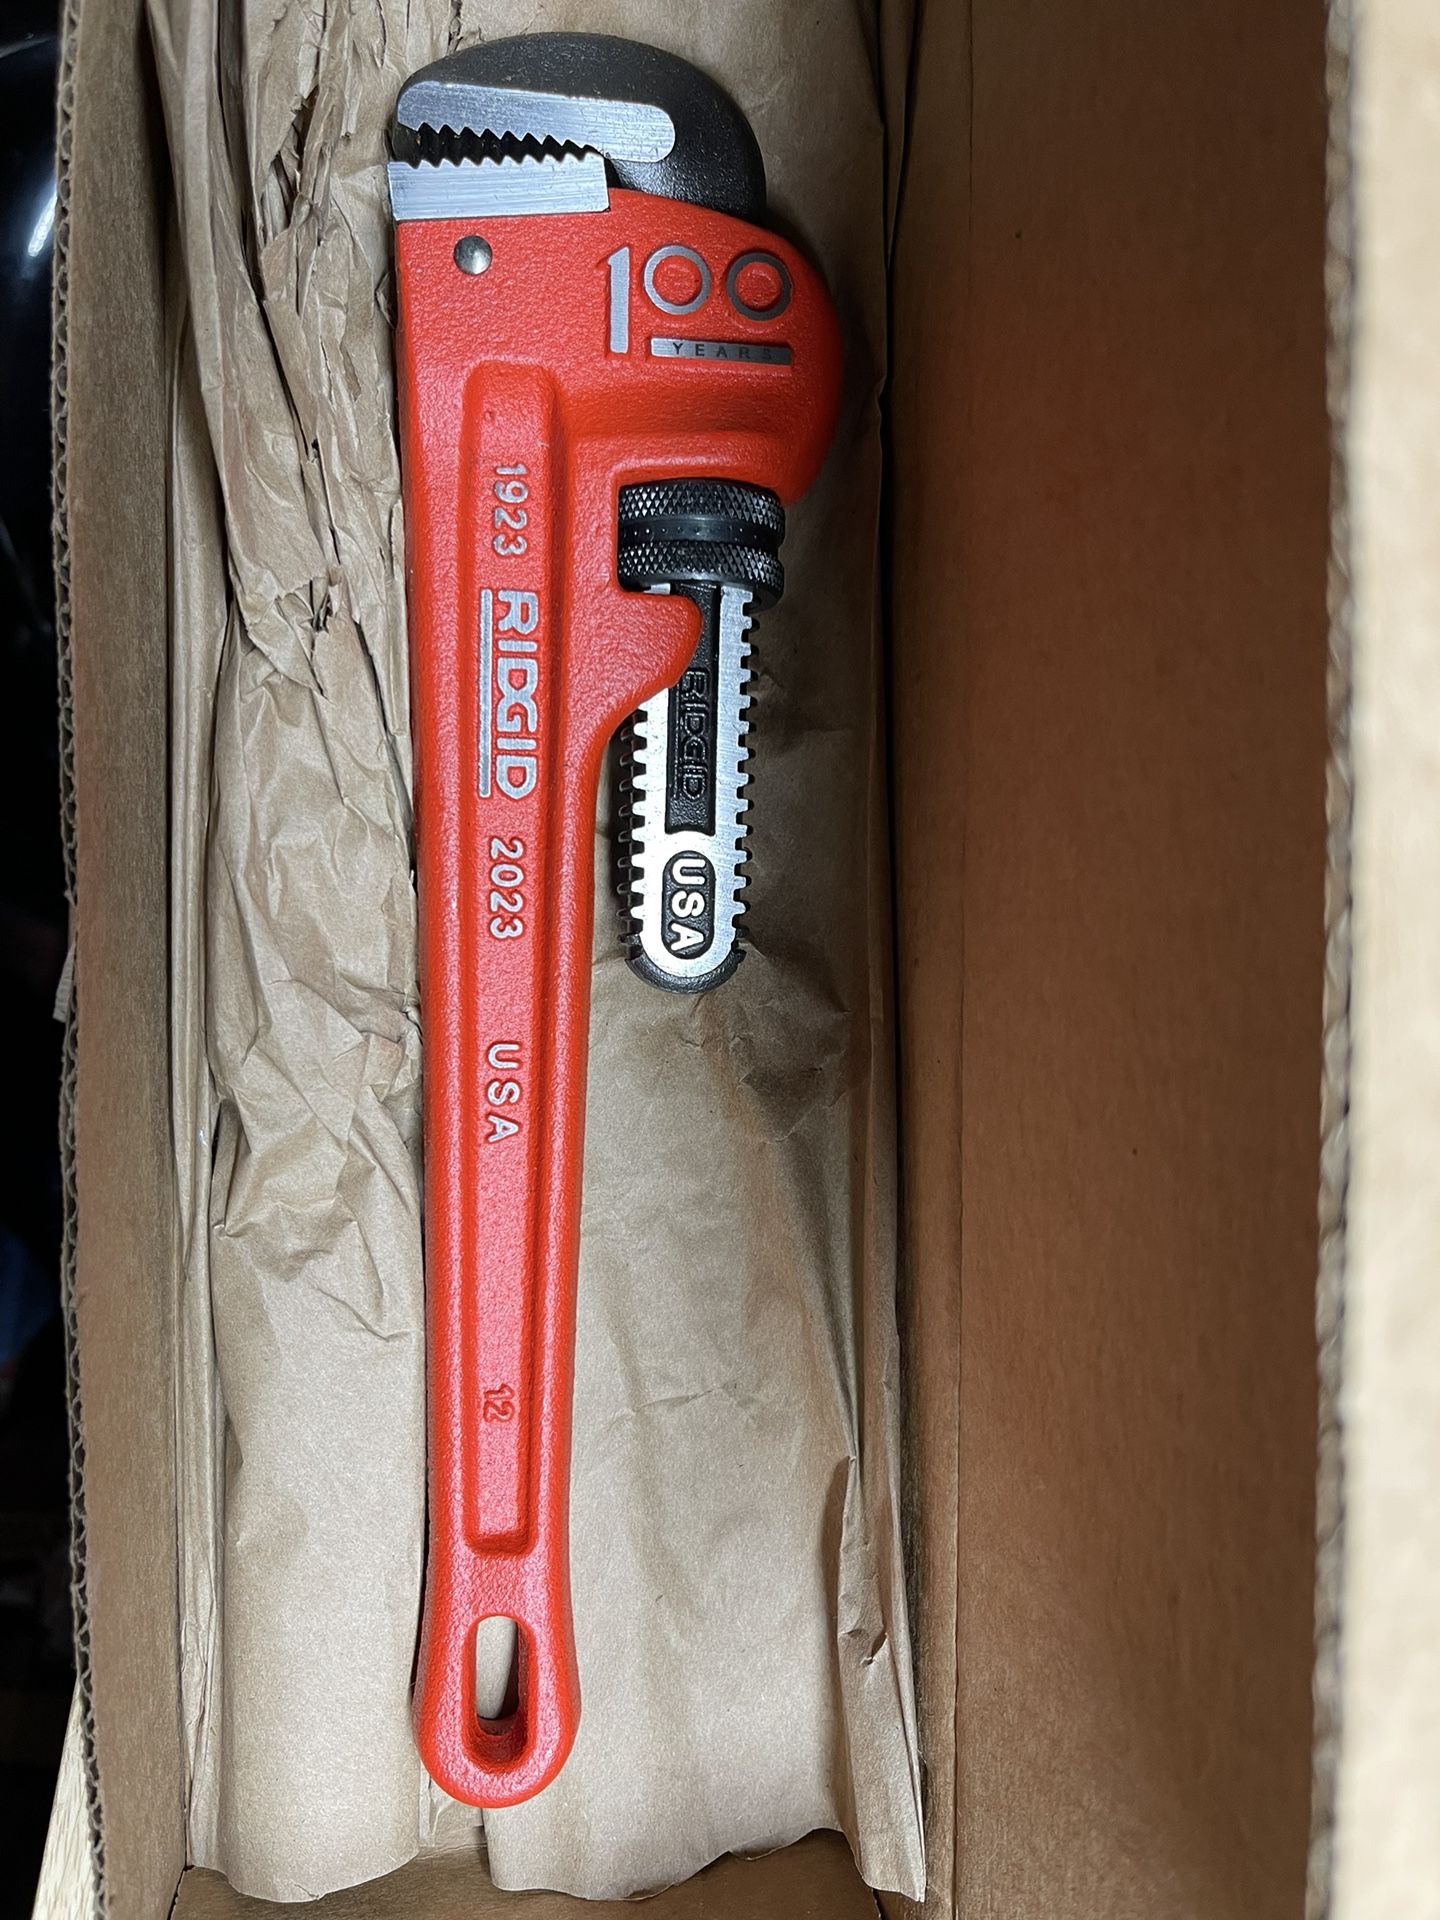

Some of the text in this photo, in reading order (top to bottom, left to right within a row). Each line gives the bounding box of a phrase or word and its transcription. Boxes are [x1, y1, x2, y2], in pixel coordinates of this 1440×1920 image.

[608, 245, 792, 353] 100
[673, 342, 772, 360] YEARS
[490, 464, 538, 939] 1923 RIDGID 2023
[681, 671, 709, 799] RIDGID
[671, 859, 706, 951] USA
[488, 1043, 520, 1143] USA
[483, 1383, 516, 1423] 12
